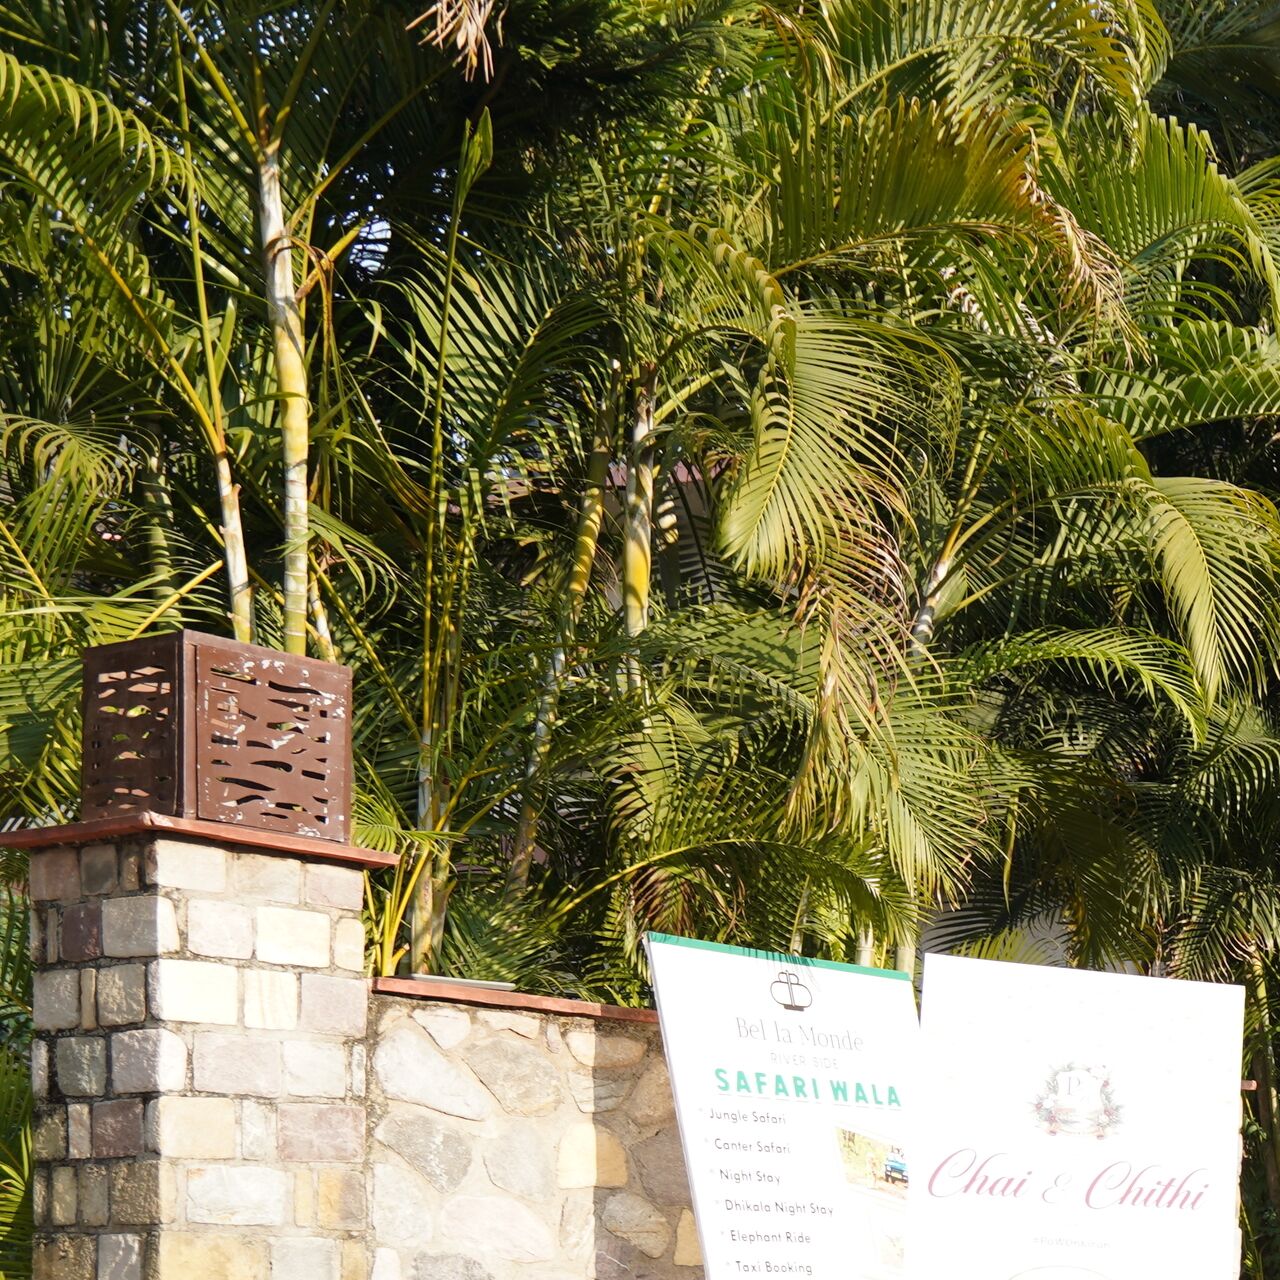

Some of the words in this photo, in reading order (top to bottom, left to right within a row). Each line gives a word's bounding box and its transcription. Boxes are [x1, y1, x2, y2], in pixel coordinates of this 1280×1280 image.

[736, 1017, 767, 1041] Bel
[774, 1021, 792, 1044] la
[799, 1025, 864, 1051] Monde
[714, 1068, 820, 1100] SAFARI
[830, 1080, 901, 1107] WALA
[710, 1108, 749, 1123] Jungle
[752, 1111, 787, 1124] Safari
[714, 1138, 753, 1152] Canter
[757, 1141, 791, 1154] Safari
[720, 1169, 752, 1183] Night
[756, 1171, 781, 1185] Stay
[927, 1148, 1032, 1198] Chai
[1085, 1161, 1209, 1210] Chithi
[725, 1199, 771, 1213] Dhikala
[775, 1201, 806, 1216] Night
[810, 1203, 834, 1216] Stay
[730, 1230, 782, 1244] Elephant
[786, 1231, 811, 1243] Ride
[736, 1260, 761, 1273] Taxi
[765, 1261, 813, 1275] Booking
